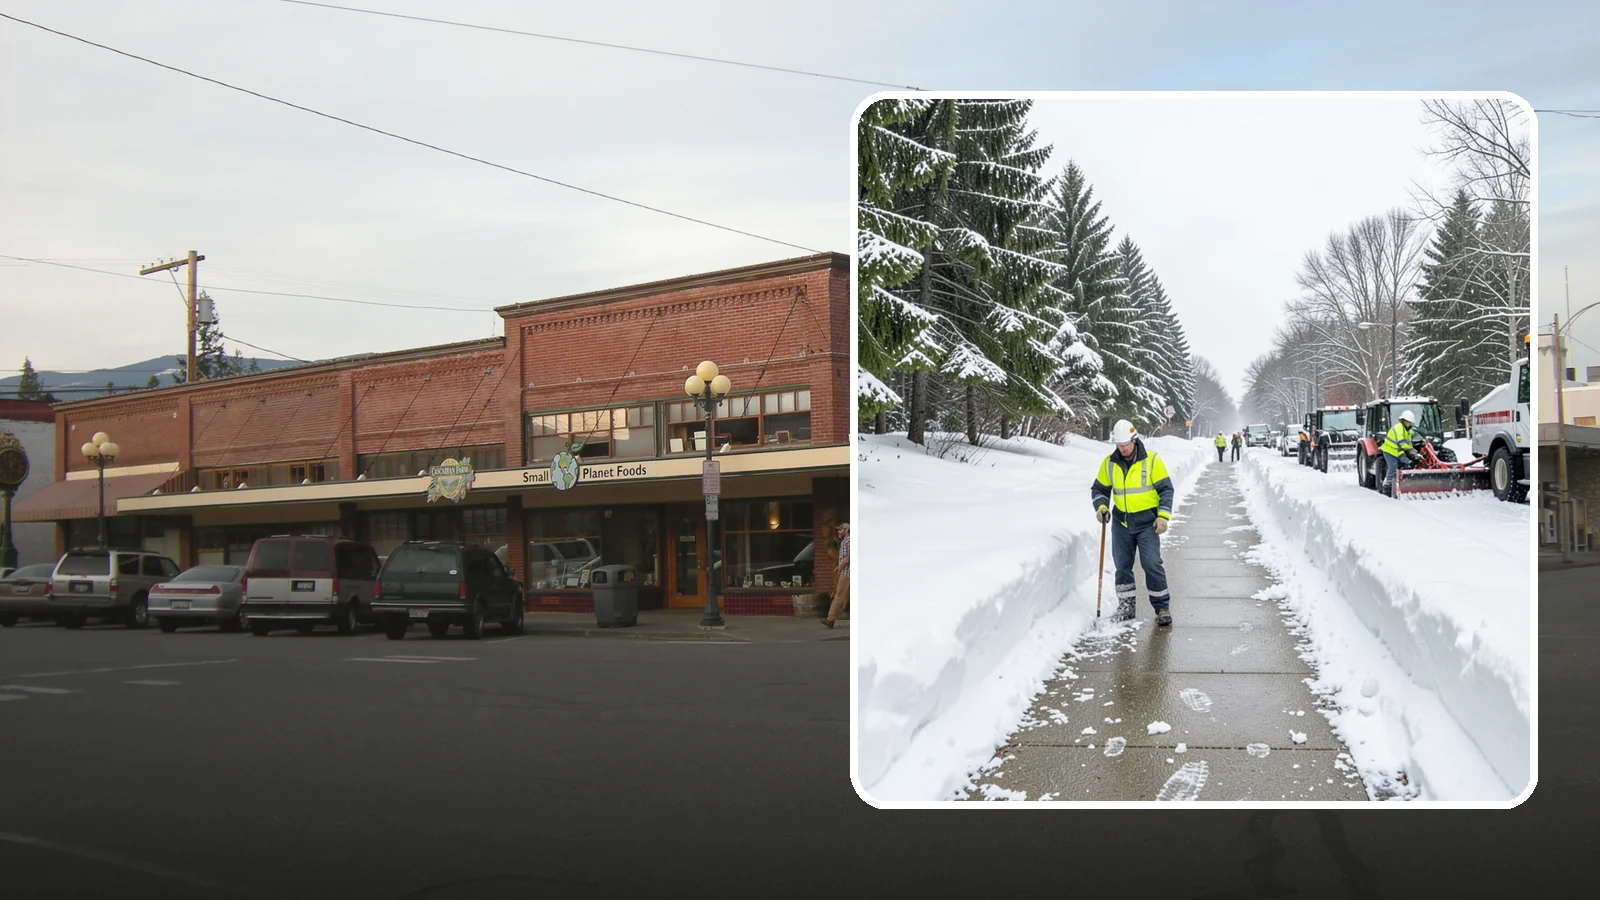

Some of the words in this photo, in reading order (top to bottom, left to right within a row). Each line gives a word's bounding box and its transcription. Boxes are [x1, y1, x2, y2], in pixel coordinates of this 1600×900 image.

[523, 470, 549, 483] Small
[582, 467, 614, 480] Planet
[616, 464, 647, 477] Foods
